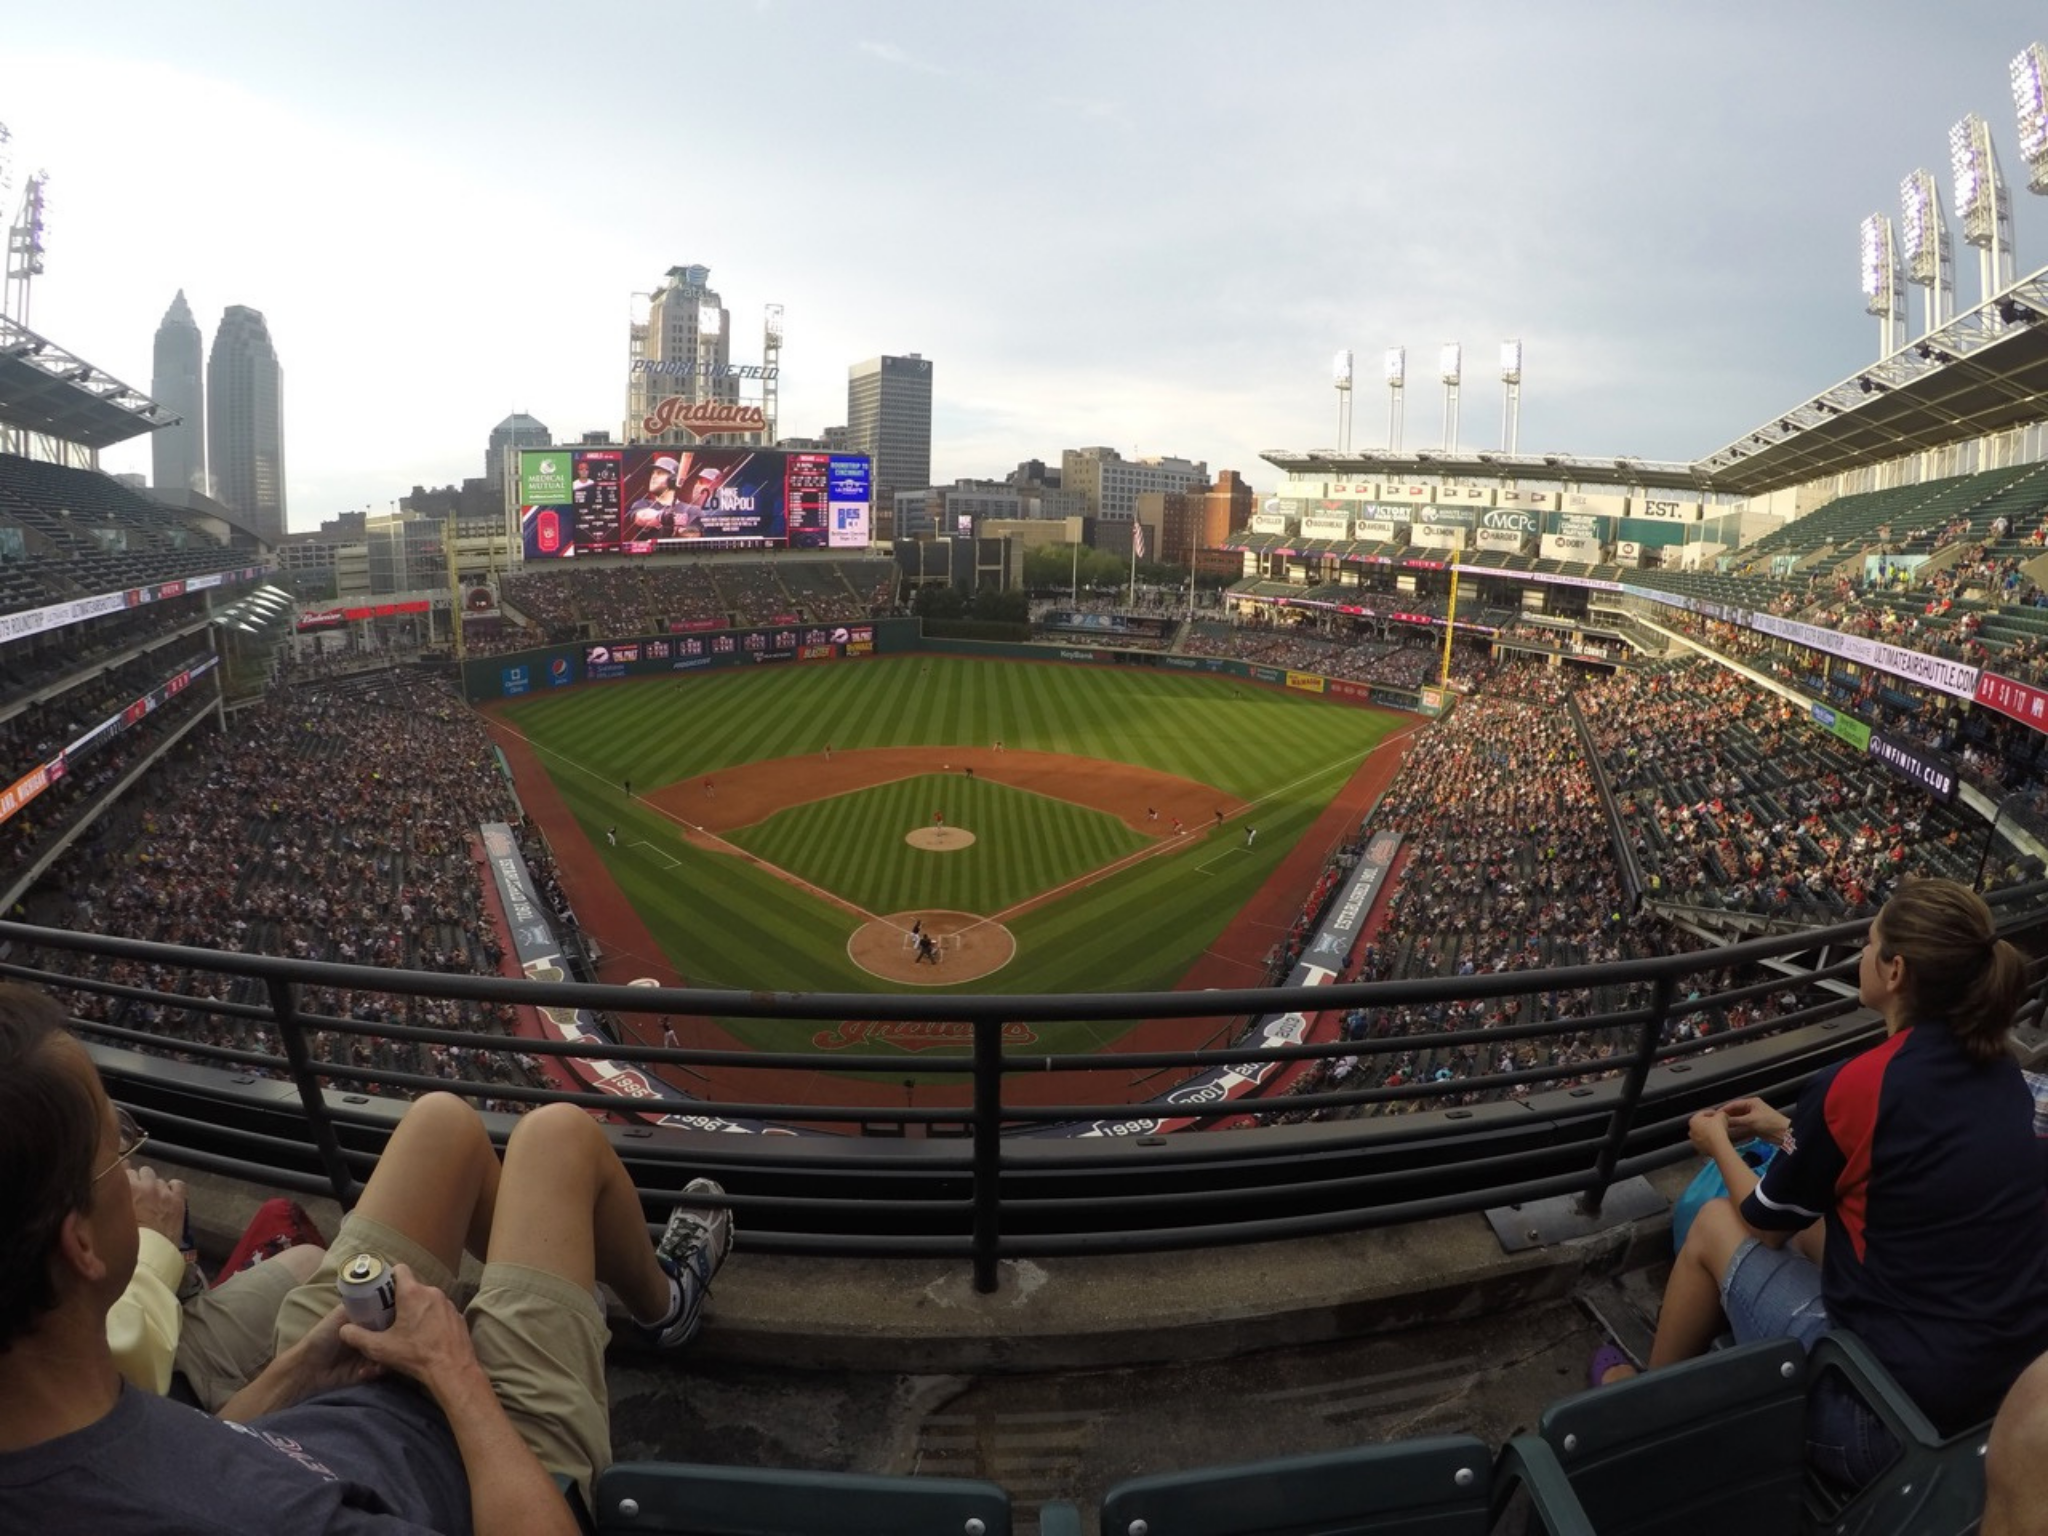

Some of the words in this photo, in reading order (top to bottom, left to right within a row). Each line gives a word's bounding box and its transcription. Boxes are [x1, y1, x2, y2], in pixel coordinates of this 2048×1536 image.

[632, 360, 738, 378] PROGRESSIVE
[738, 365, 779, 380] FIELD
[643, 396, 766, 438] Indians
[528, 475, 565, 483] MEDICAL
[528, 482, 565, 491] MUTUAL
[721, 487, 738, 496] MIKE
[700, 488, 719, 511] 26
[721, 496, 755, 511] NAPOLI
[1366, 505, 1412, 517] VICTORY
[1645, 500, 1683, 519] EST.
[1432, 527, 1455, 537] LEMON
[1489, 531, 1518, 542] HARDER
[1565, 539, 1586, 548] DOBY
[302, 612, 342, 624] Budweiser
[1060, 650, 1094, 660] KeyBank
[1873, 646, 1977, 694] ULTIMATEAIRSHUTTLE.COM
[1881, 742, 1921, 778] INFINITI
[1924, 767, 1951, 795] CLUB
[611, 1074, 649, 1099] 1995
[1103, 1118, 1154, 1137] 1999
